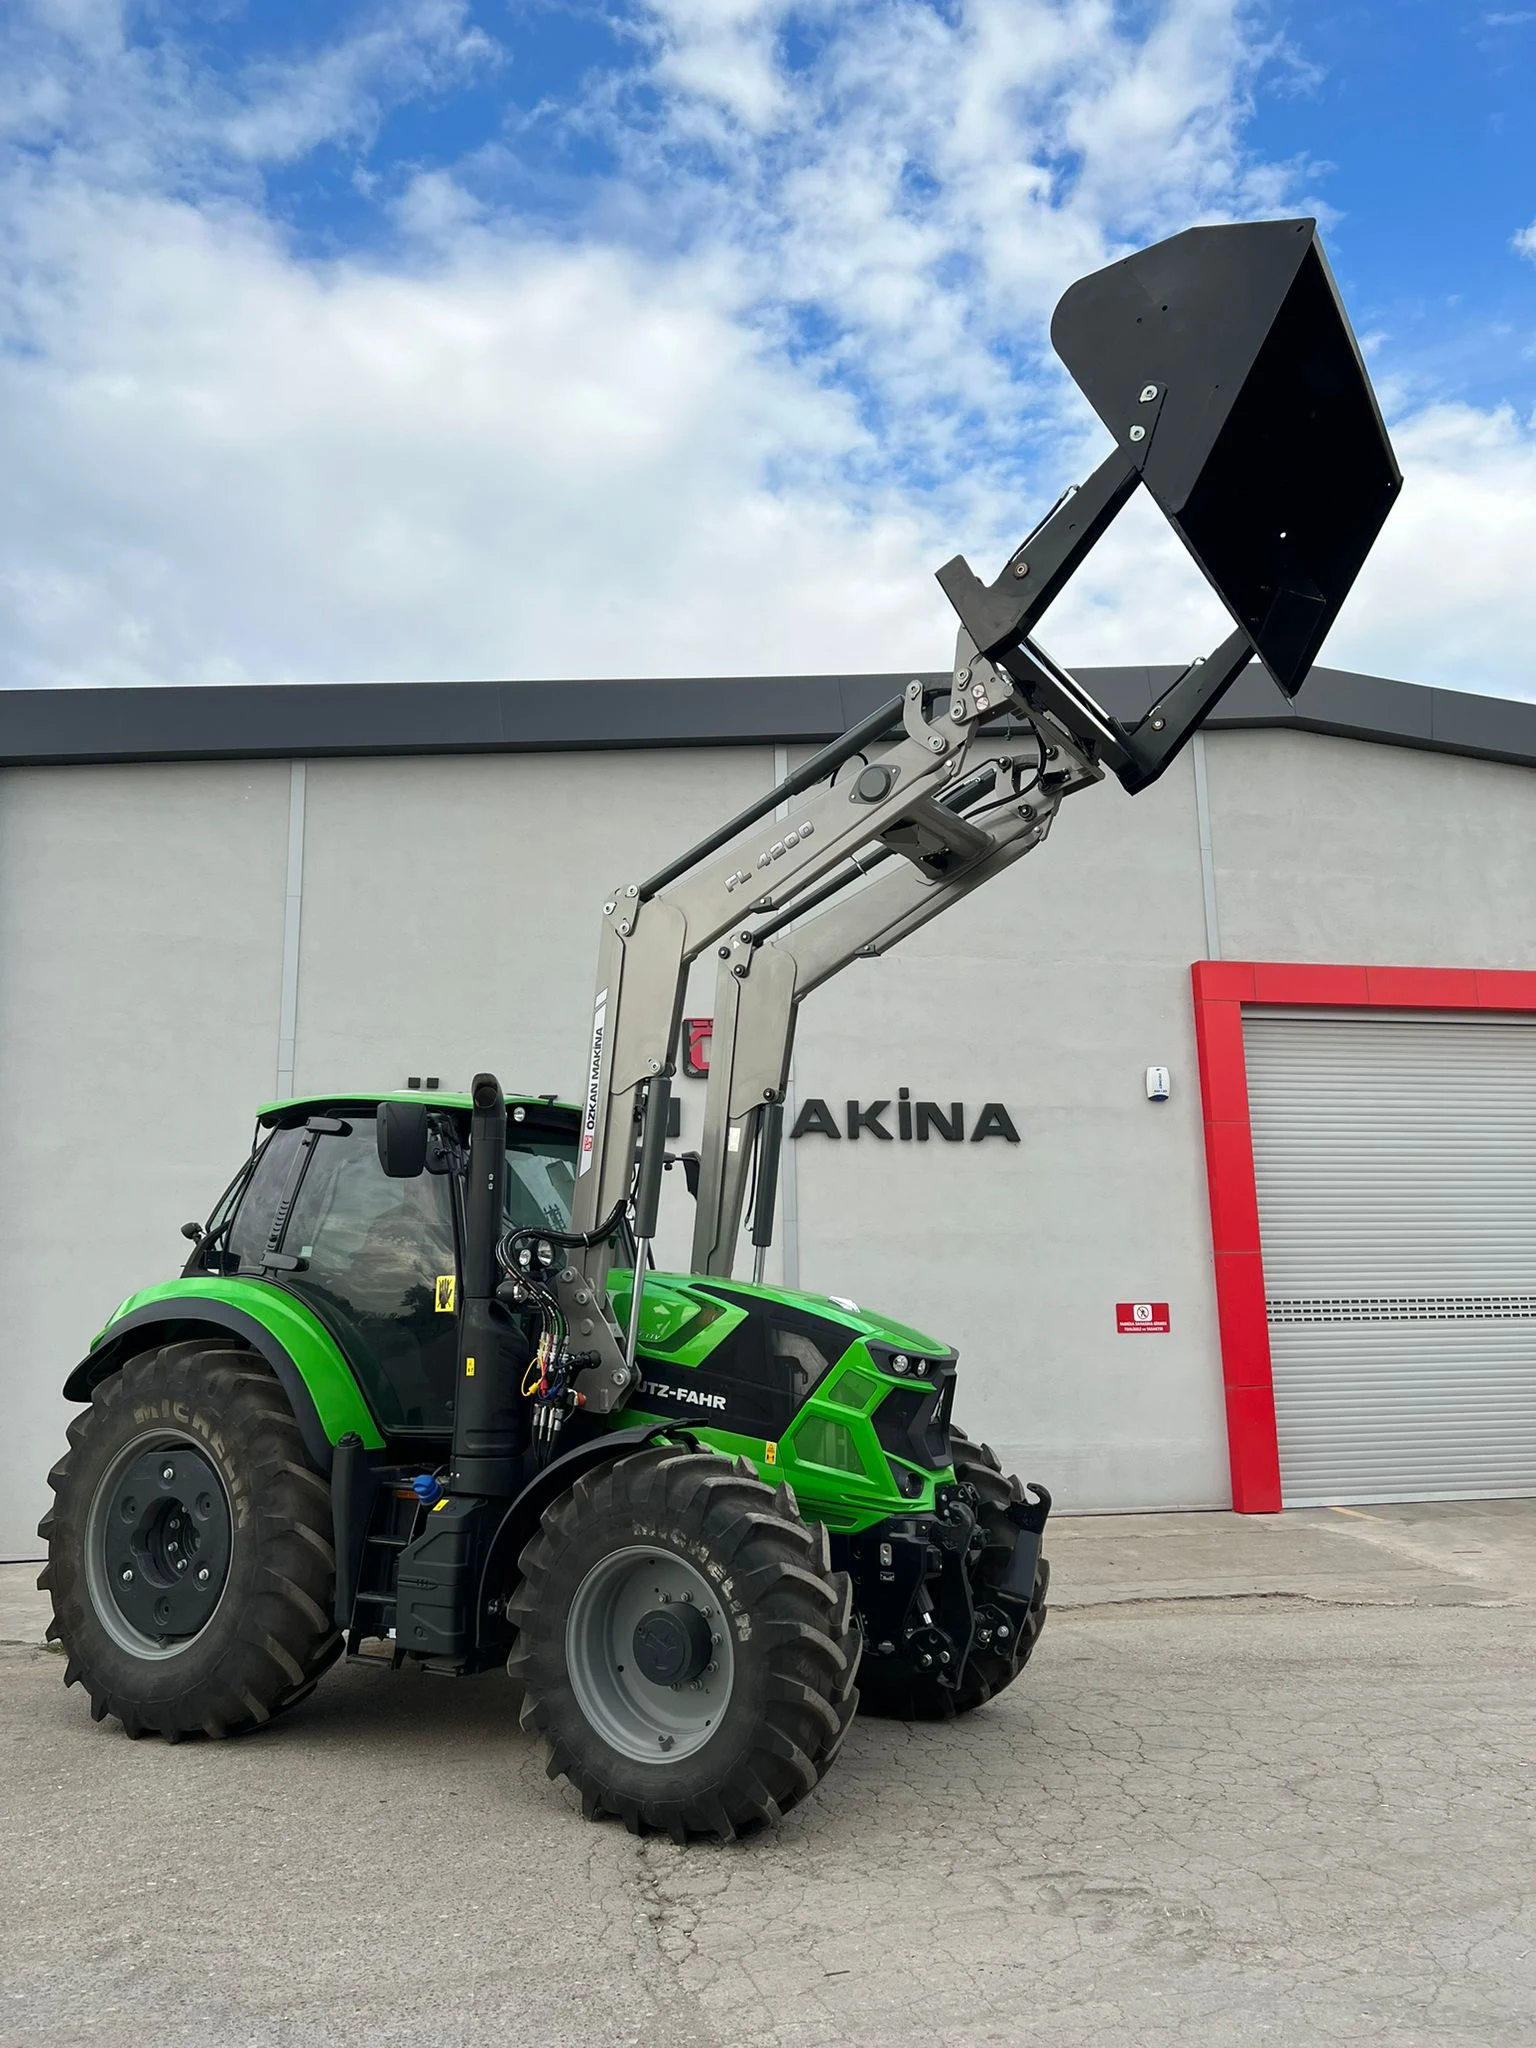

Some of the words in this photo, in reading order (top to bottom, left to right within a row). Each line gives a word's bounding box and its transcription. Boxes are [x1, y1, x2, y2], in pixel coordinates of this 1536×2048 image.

[724, 870, 752, 893] FL
[757, 820, 815, 870] 4200
[790, 1087, 1021, 1142] AKİNA
[636, 1380, 727, 1411] UTZ-FAHR
